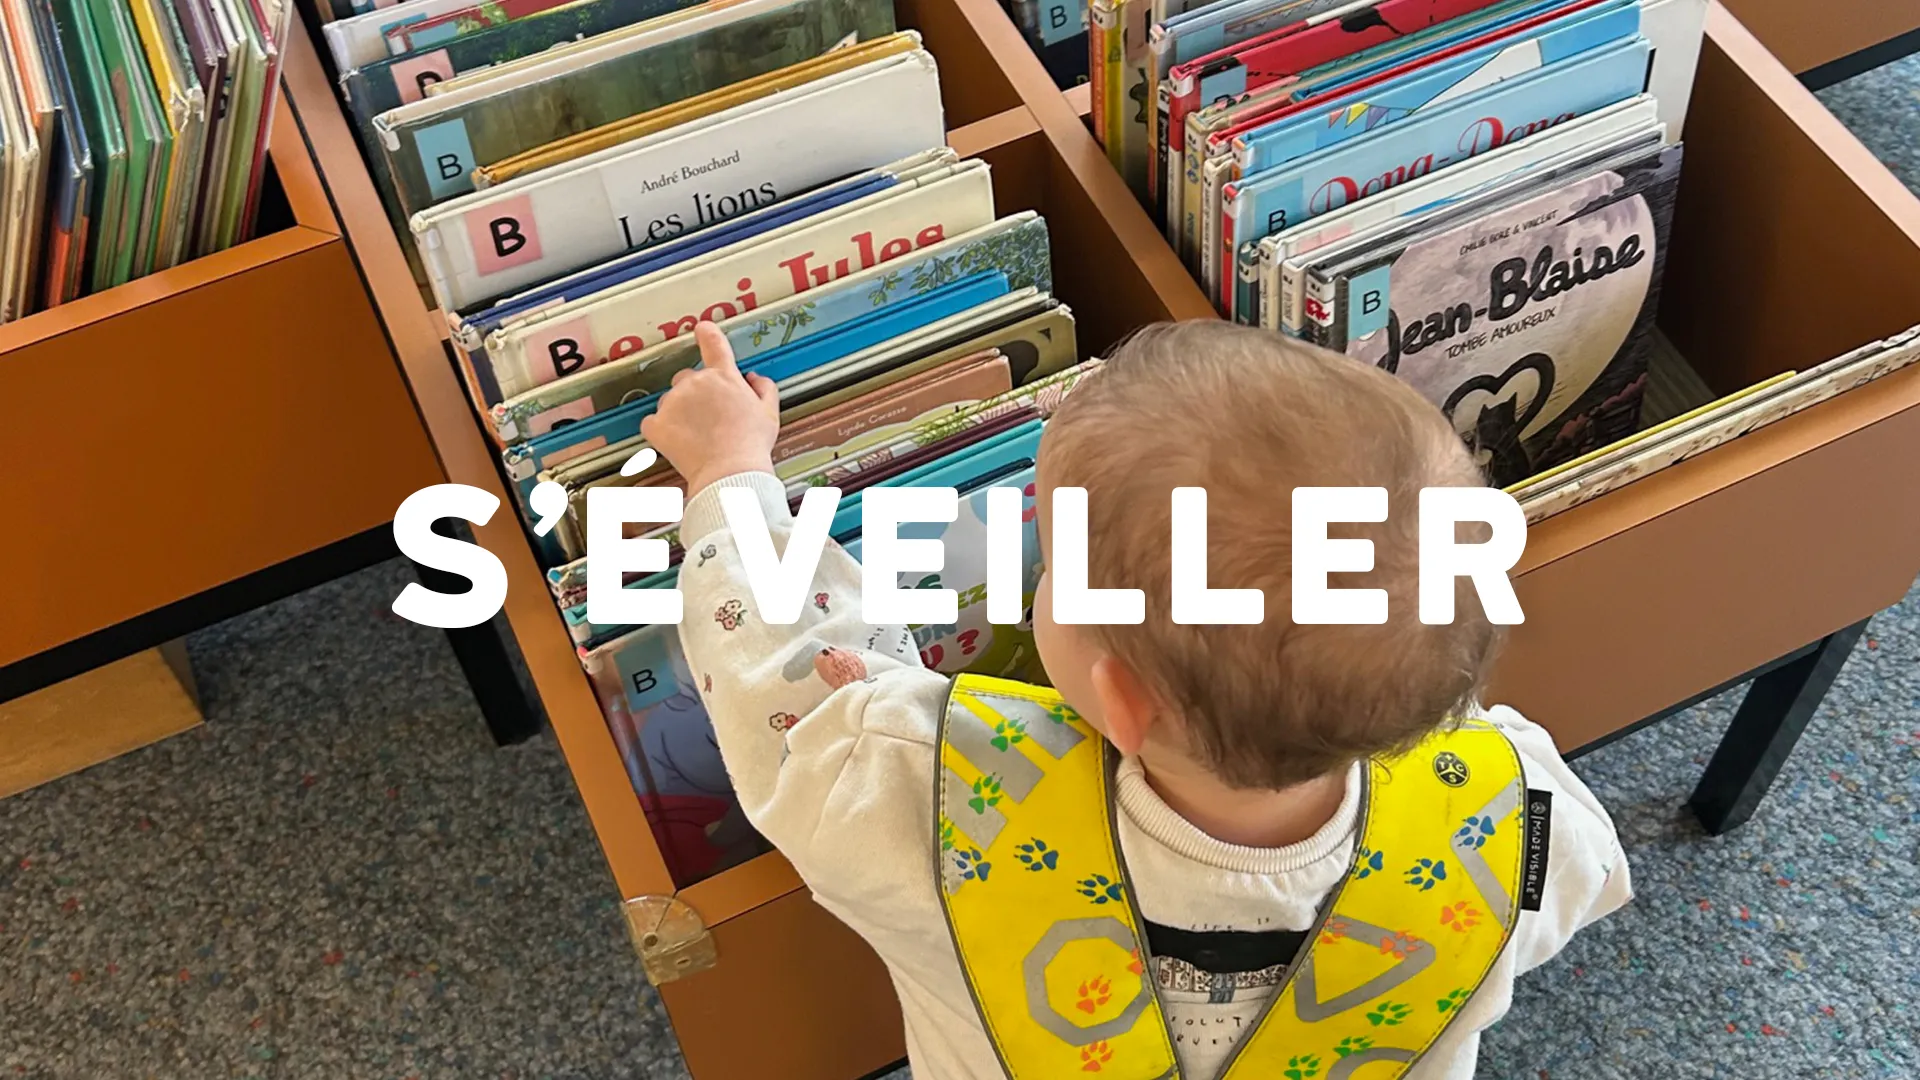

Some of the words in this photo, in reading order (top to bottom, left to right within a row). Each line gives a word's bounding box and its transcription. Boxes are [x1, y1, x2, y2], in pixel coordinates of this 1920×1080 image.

[1050, 5, 1068, 29] B
[436, 153, 463, 180] B
[640, 170, 679, 194] André
[681, 150, 741, 181] Bouchard
[618, 212, 685, 250] Les
[692, 181, 778, 226] lions
[1268, 209, 1288, 235] B
[489, 217, 526, 258] B
[778, 223, 945, 295] Jules
[1361, 289, 1382, 316] B
[1444, 335, 1488, 360] TOMBE
[1489, 306, 1557, 343] AMOUREUX
[547, 338, 585, 378] B
[631, 668, 657, 695] B
